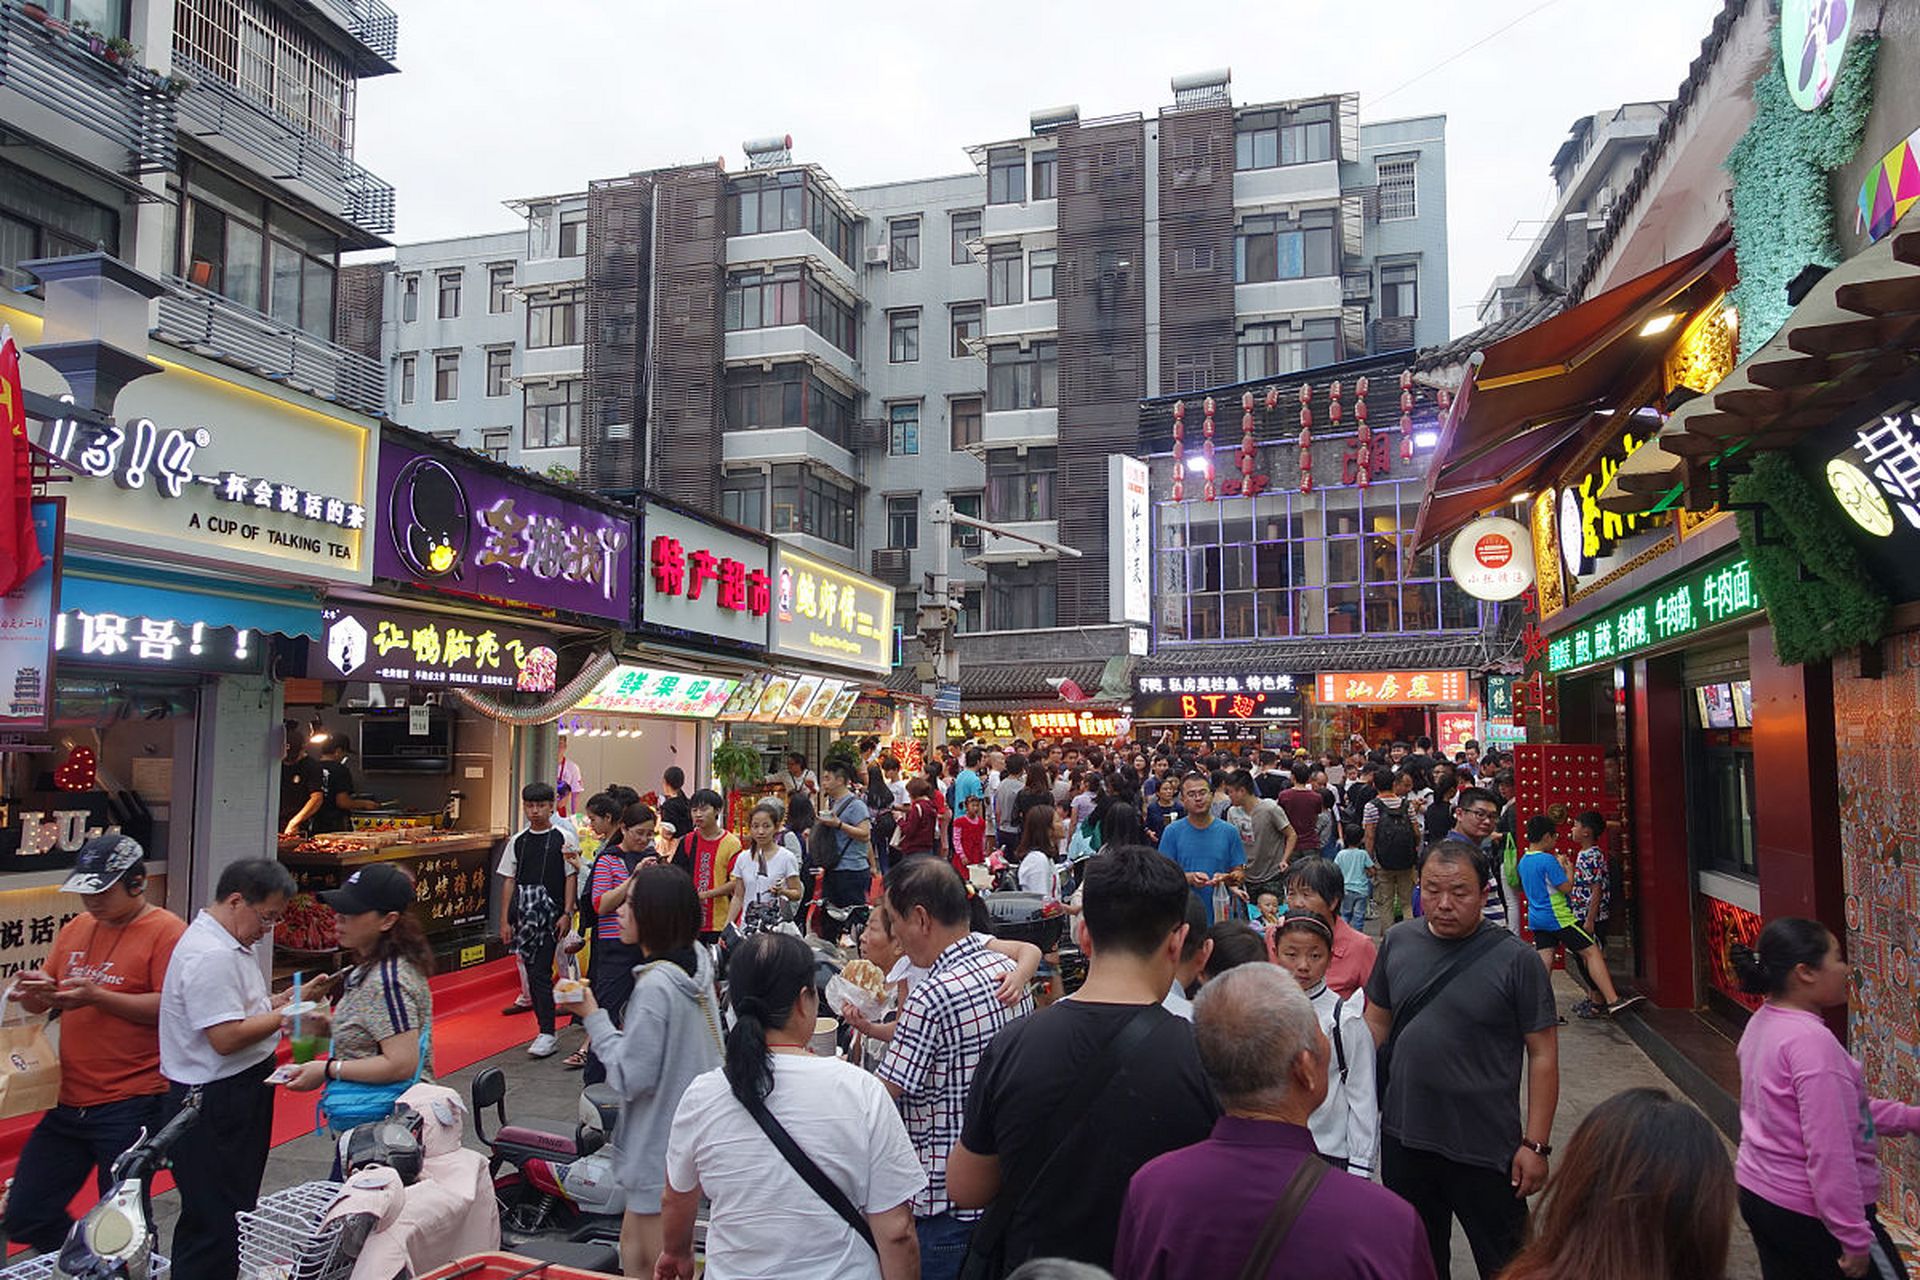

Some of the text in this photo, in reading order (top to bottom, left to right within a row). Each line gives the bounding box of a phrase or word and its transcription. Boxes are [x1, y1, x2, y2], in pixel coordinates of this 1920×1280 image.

[198, 472, 366, 530] 一杯会说话的茶
[189, 512, 351, 560] A CUP OF TALKING TEA
[651, 535, 772, 617] 特产超市
[795, 570, 858, 634] 鲍师傅
[616, 671, 711, 700] 鲜果吧
